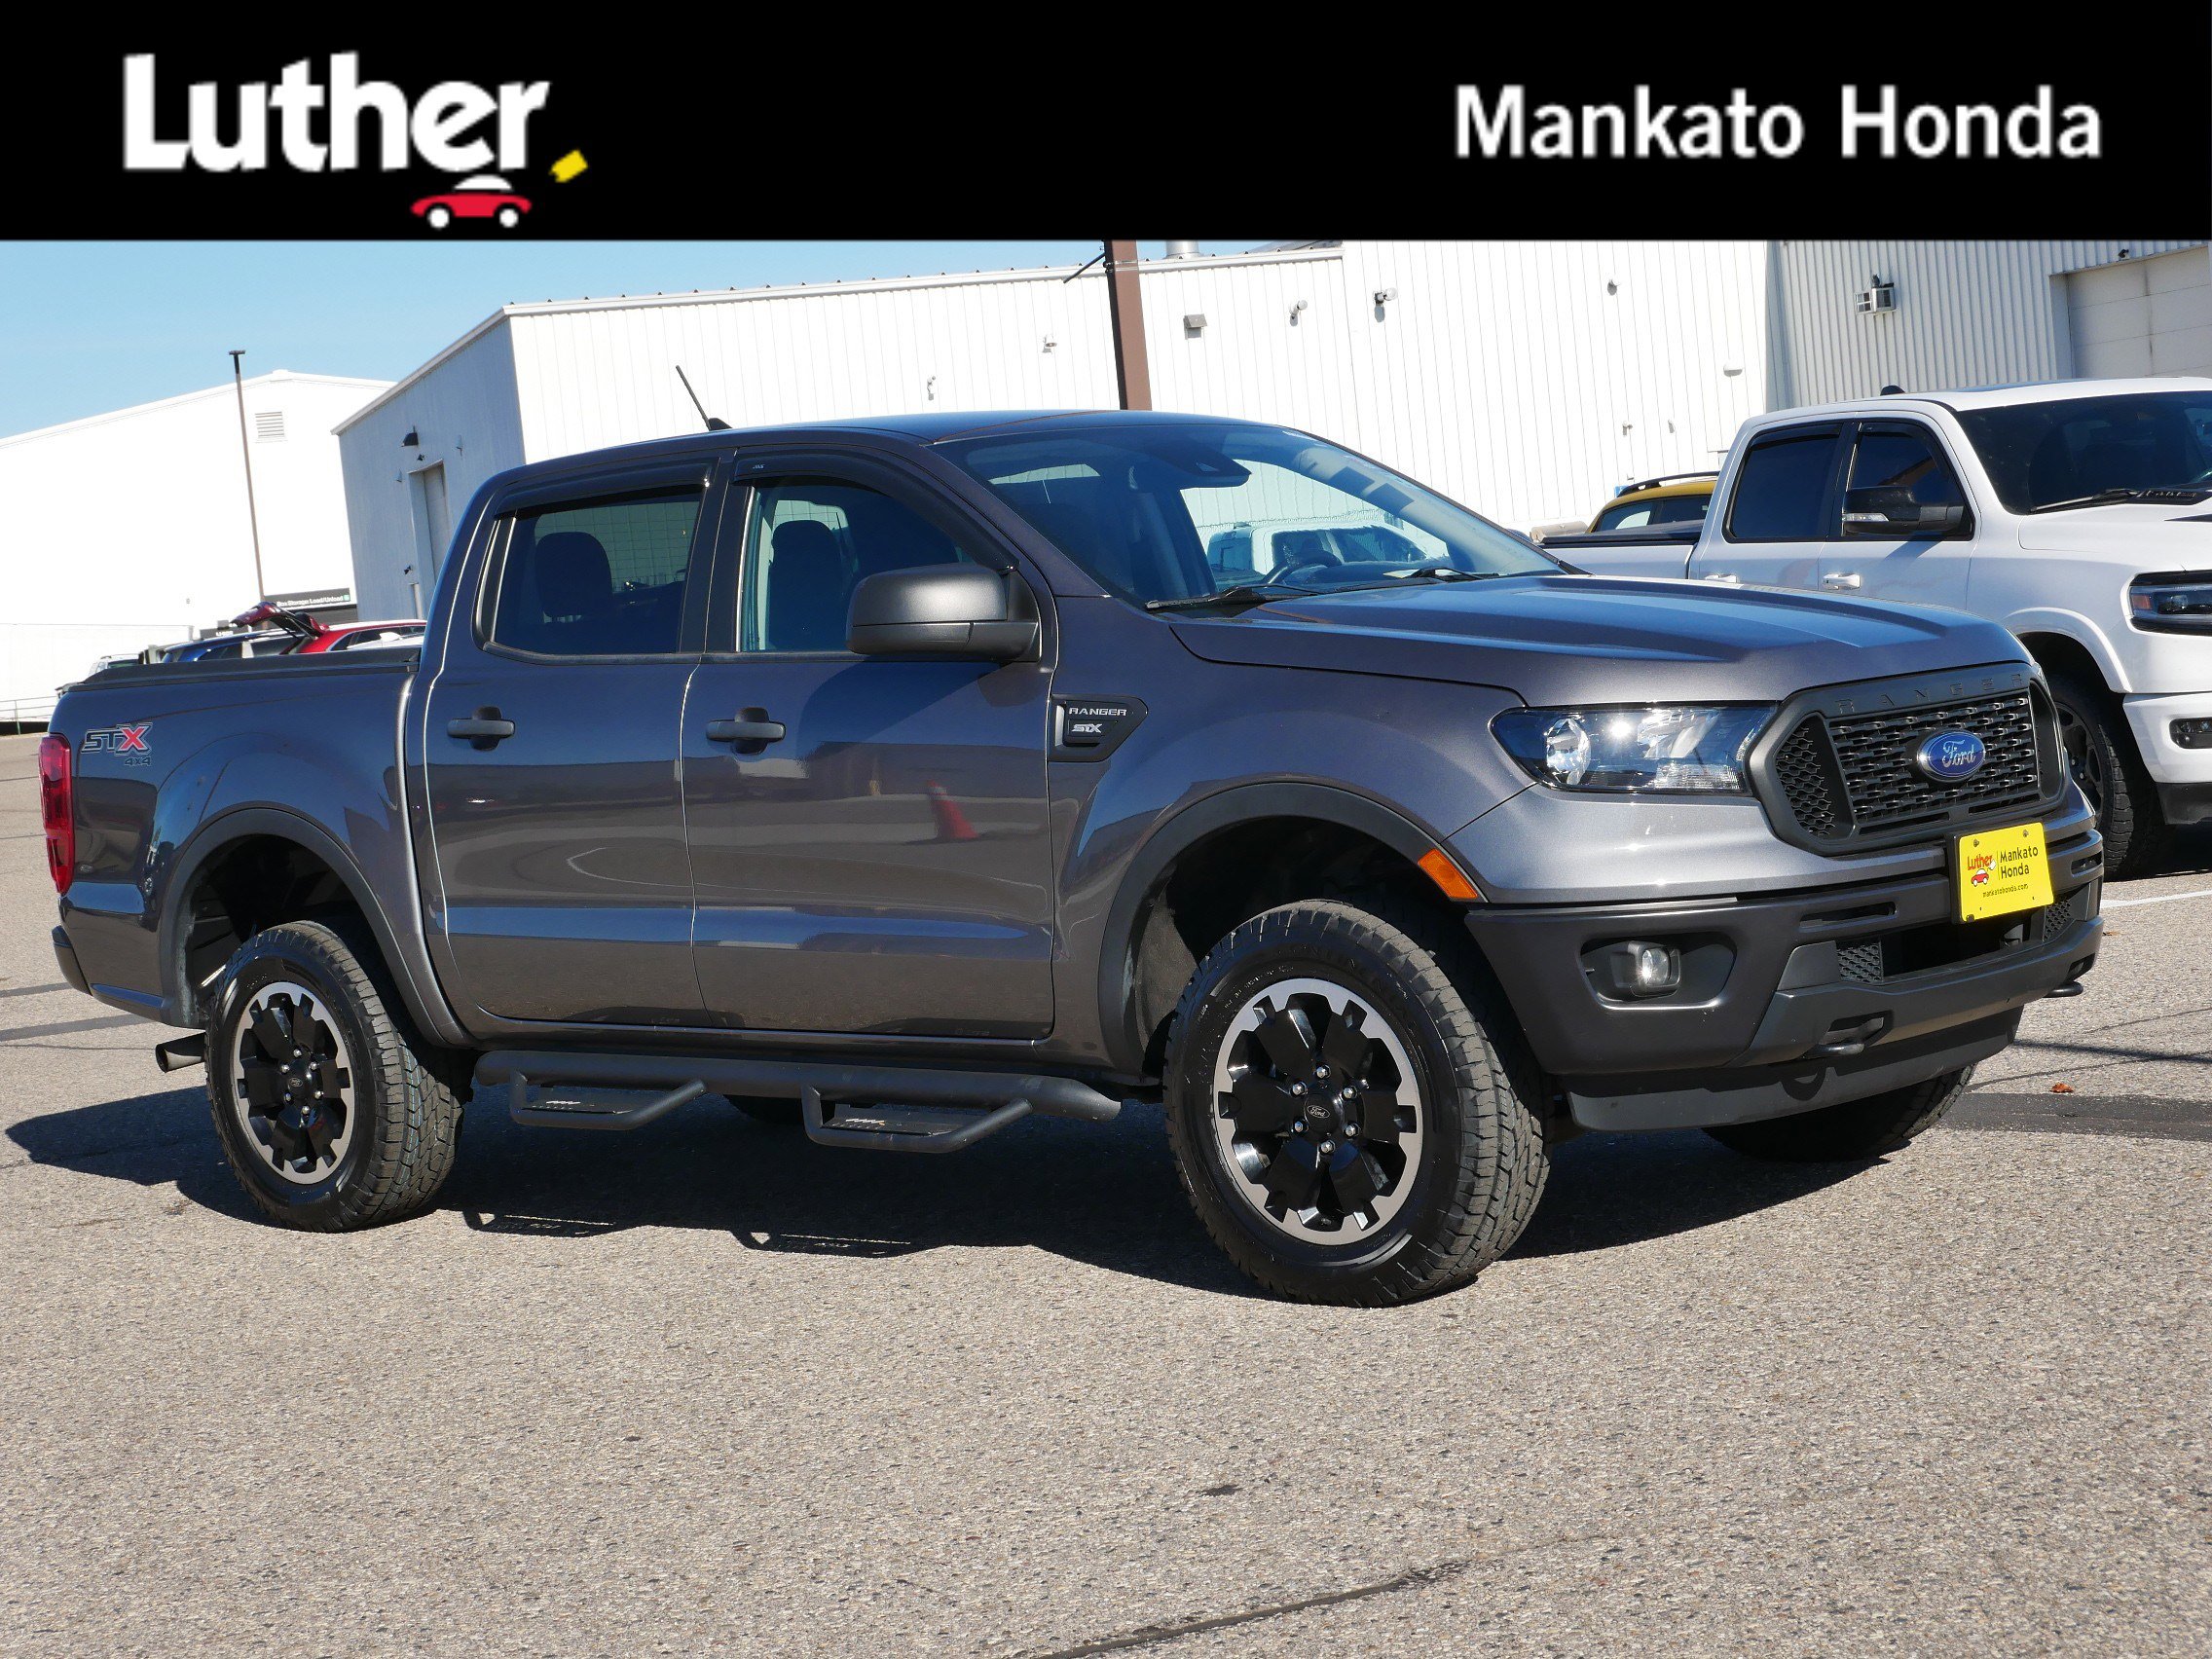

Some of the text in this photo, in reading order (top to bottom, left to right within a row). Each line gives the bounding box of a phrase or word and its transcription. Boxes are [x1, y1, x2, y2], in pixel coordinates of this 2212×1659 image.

[1835, 674, 2024, 714] RANGER
[1068, 707, 1127, 717] RANGER
[1071, 723, 1103, 733] STX
[81, 721, 153, 756] STX
[1941, 739, 1976, 768] Ford
[1967, 853, 1994, 870] Luther
[2000, 846, 2039, 864] Mankato
[2001, 863, 2030, 879] Honda
[1309, 1106, 1326, 1117] Ford
